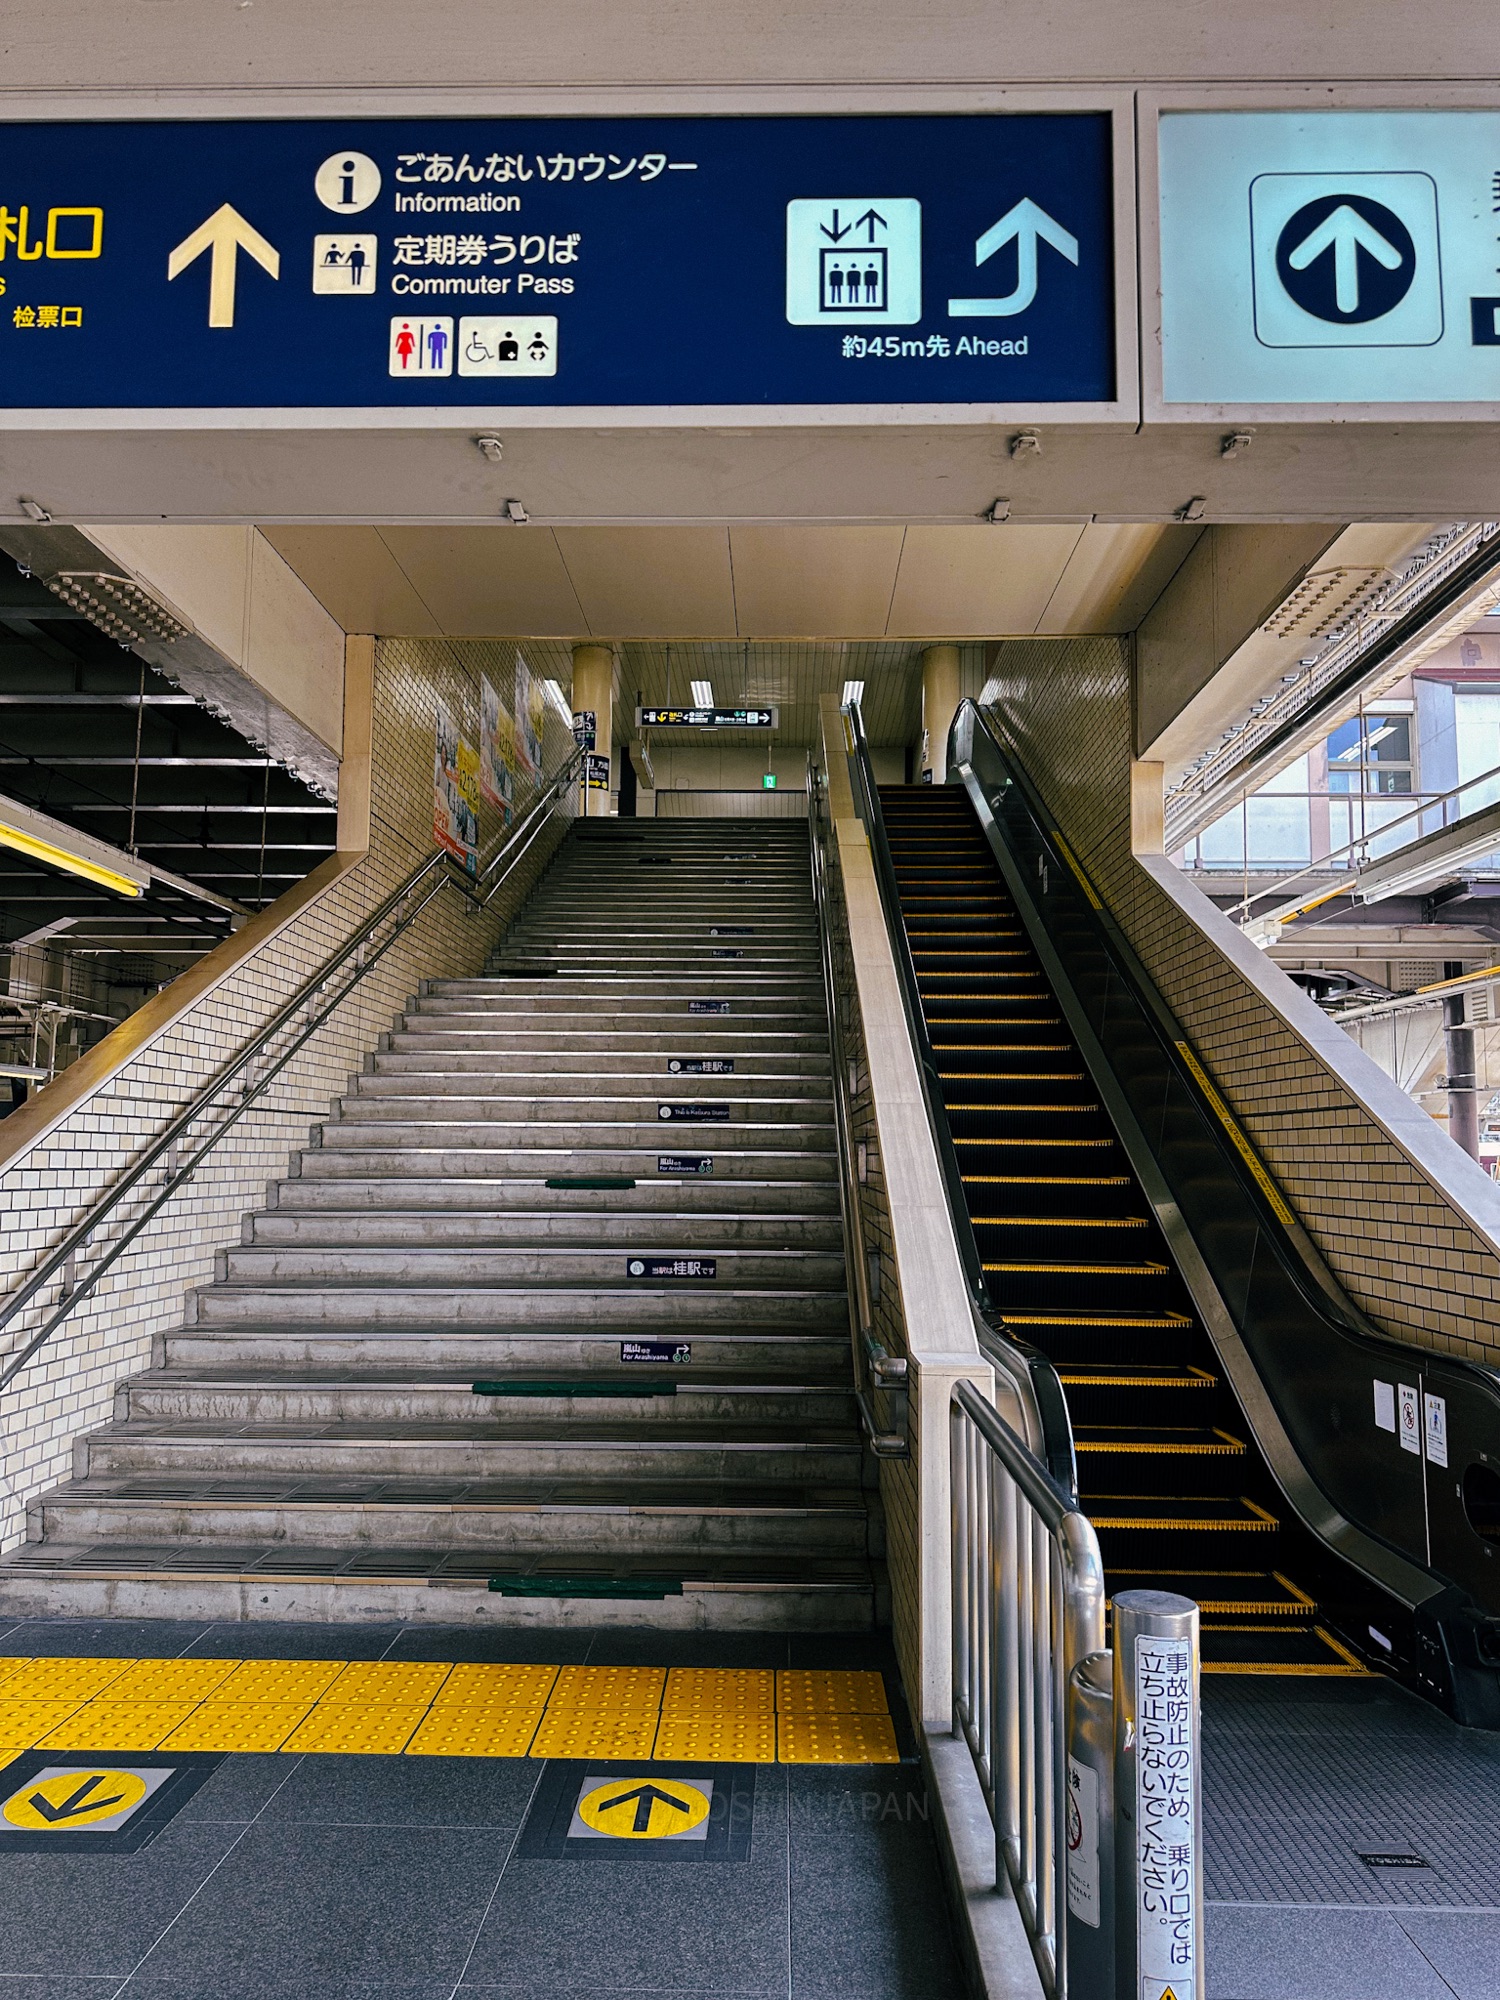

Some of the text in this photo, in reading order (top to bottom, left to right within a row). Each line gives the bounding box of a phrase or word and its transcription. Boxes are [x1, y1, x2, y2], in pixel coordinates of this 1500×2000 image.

[396, 153, 698, 183] ごあんないカウンター
[395, 192, 521, 213] Information
[393, 233, 580, 266] 定期券うりば
[391, 273, 575, 295] Commuter Pass
[12, 305, 83, 329] 检票口
[843, 335, 1028, 358] 約45m先 Ahead
[652, 1261, 715, 1275] 当駅は桂駅です
